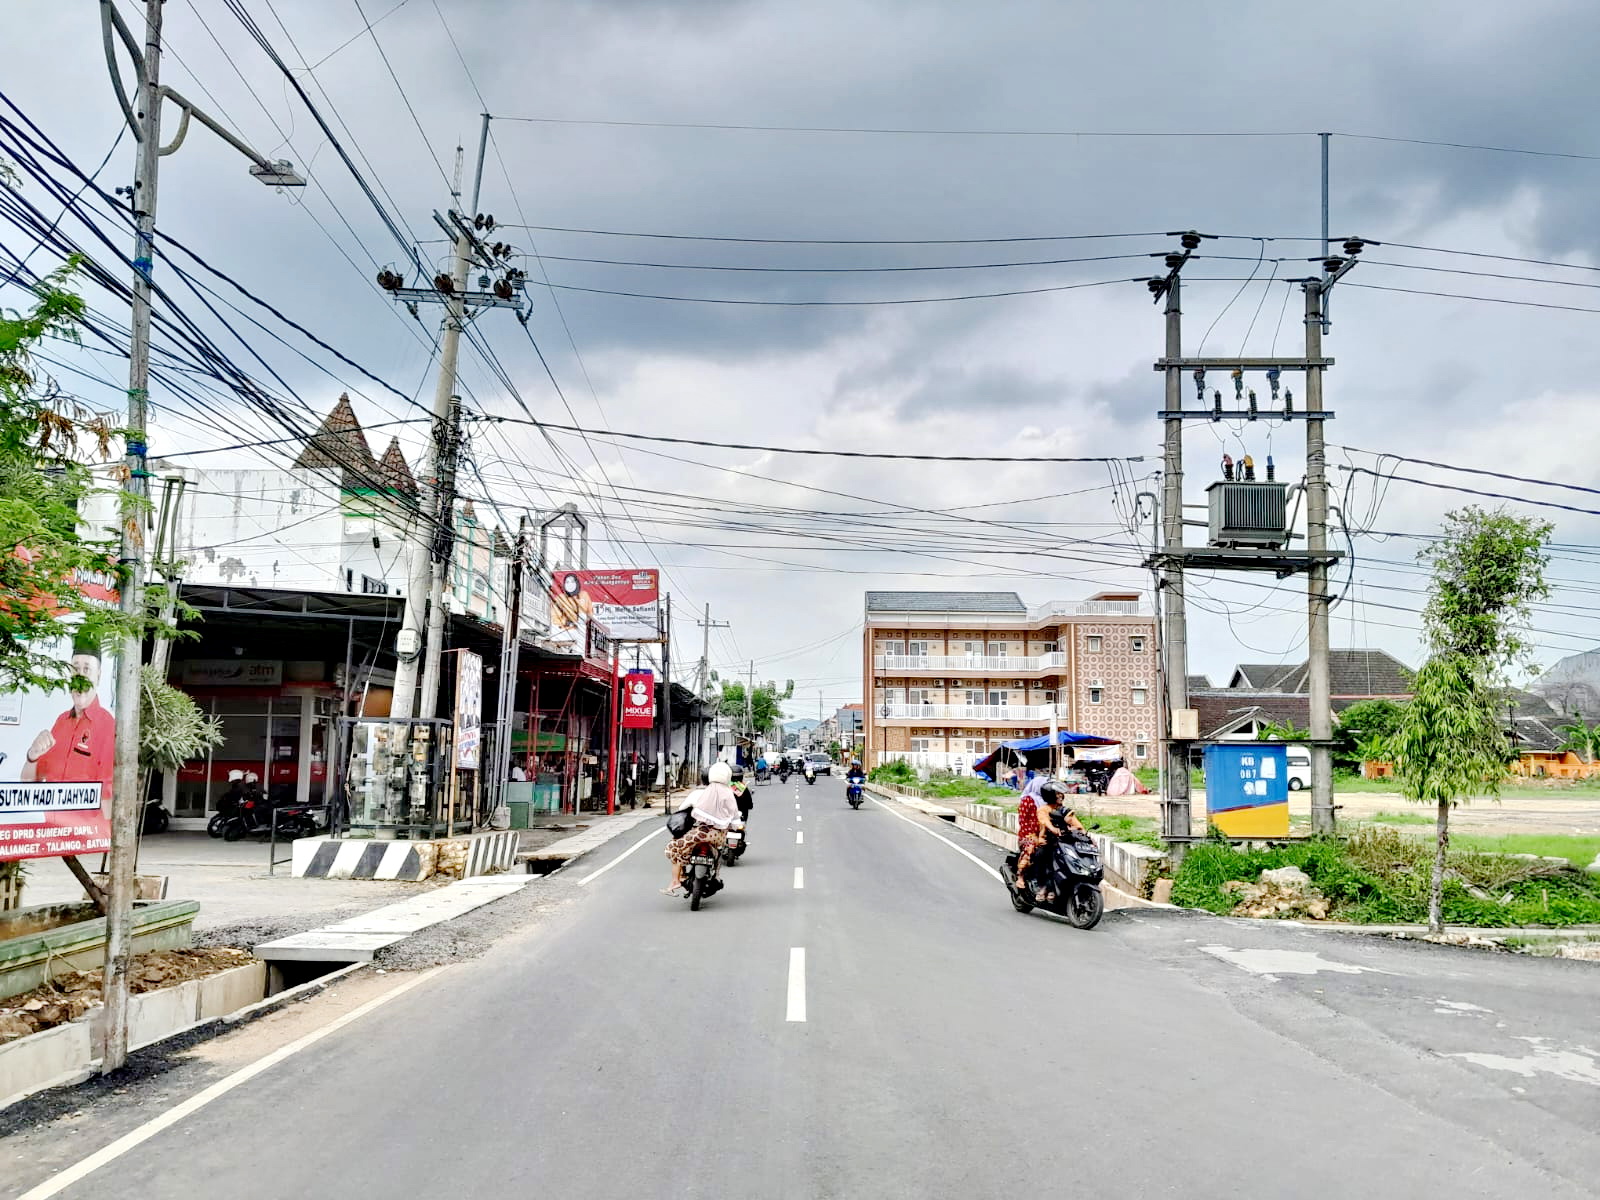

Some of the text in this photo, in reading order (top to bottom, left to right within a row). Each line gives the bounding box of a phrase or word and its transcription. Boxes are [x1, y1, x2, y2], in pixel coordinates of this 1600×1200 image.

[625, 706, 652, 715] MIXUE
[0, 788, 99, 806] SUTAN HADI TJAHYADI
[13, 829, 34, 839] DPRD
[36, 827, 73, 838] SUMENEP
[74, 826, 94, 836] DAPIL
[0, 844, 41, 855] ALIANGET
[47, 841, 81, 852] TALANGO
